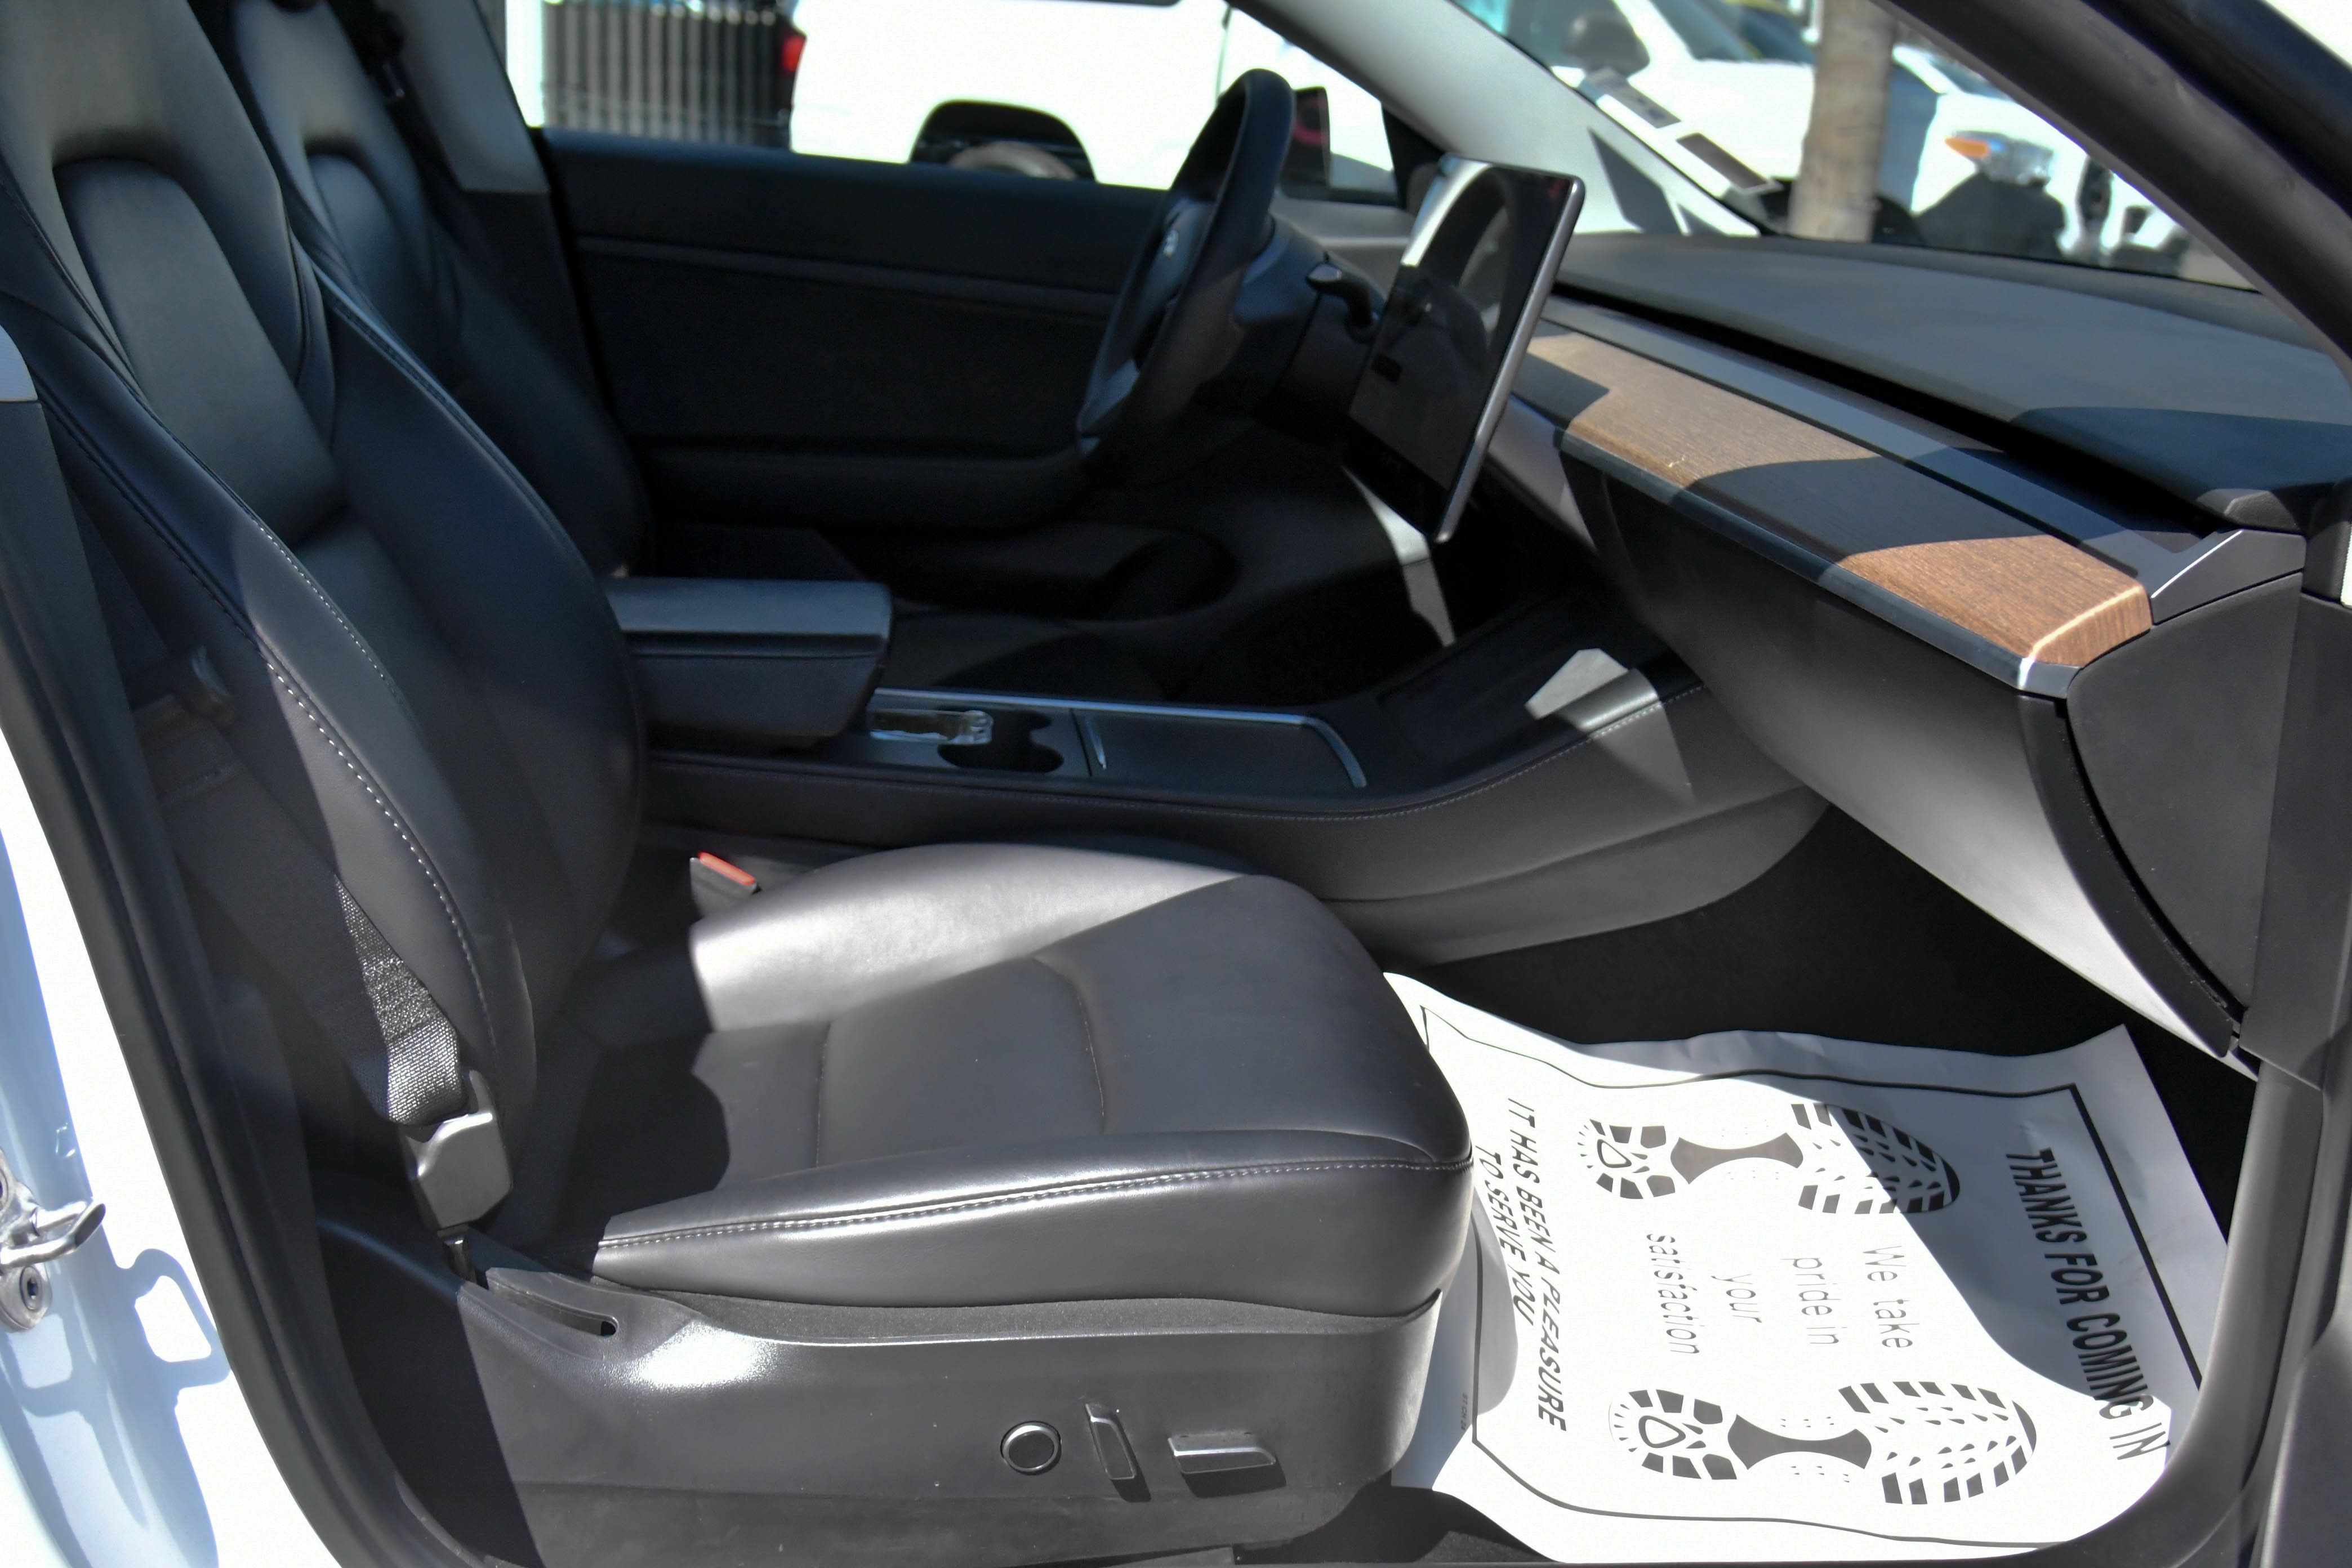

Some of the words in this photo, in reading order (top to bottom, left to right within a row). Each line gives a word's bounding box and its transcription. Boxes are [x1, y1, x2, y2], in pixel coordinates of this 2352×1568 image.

[1508, 1098, 1535, 1128] IT
[1475, 1145, 1504, 1179] TO
[1510, 1129, 1540, 1184] HAS
[1484, 1179, 1527, 1262] SERVE
[1516, 1185, 1556, 1253] BEEN
[2006, 1147, 2088, 1243] THANKS
[1538, 1251, 1560, 1275] A
[1780, 1257, 1841, 1316] pride
[1863, 1245, 1906, 1281] We
[2044, 1253, 2110, 1304] FOR
[1507, 1263, 1535, 1326] YOU
[1646, 1233, 1705, 1354] satisfaction
[1711, 1273, 1762, 1323] your
[1806, 1326, 1848, 1344] in
[1873, 1300, 1919, 1348] take
[1538, 1276, 1567, 1432] PLEASURE
[2066, 1313, 2154, 1419] COMING
[2109, 1423, 2171, 1460] IN
